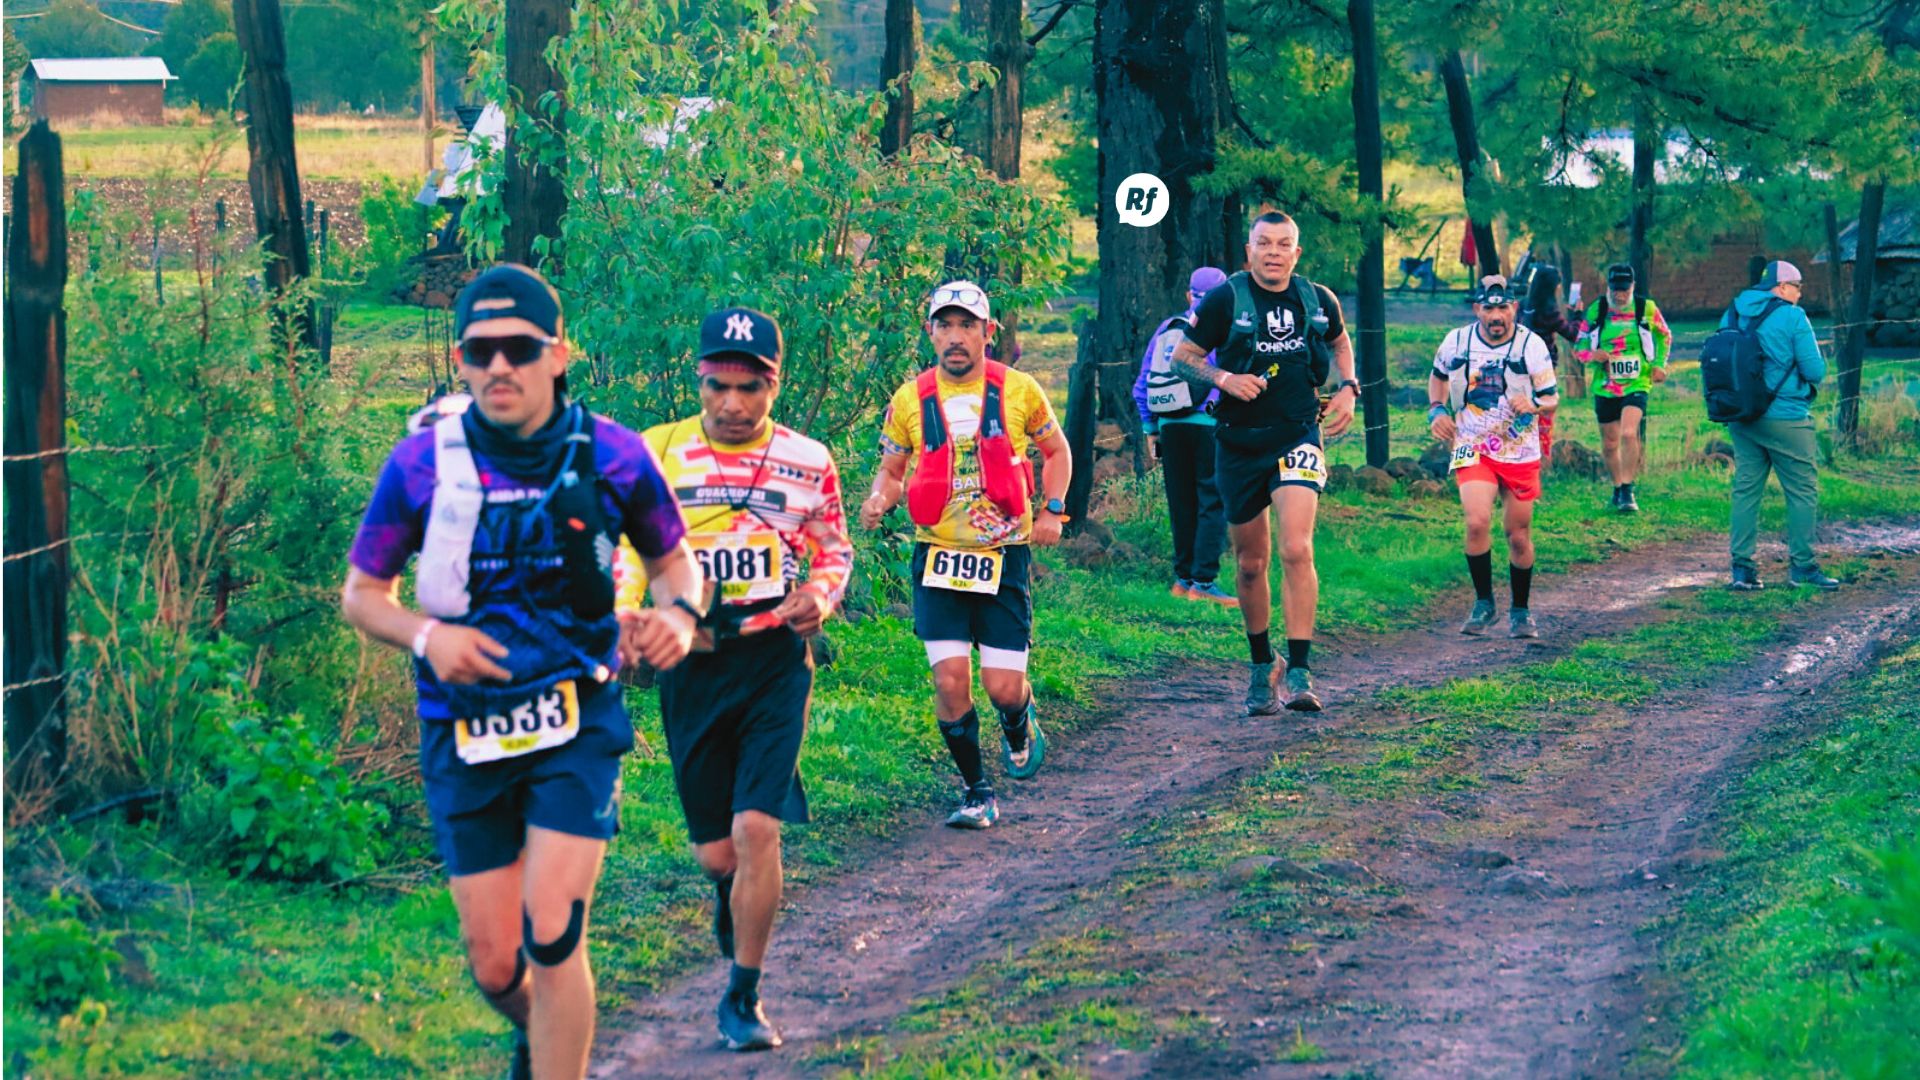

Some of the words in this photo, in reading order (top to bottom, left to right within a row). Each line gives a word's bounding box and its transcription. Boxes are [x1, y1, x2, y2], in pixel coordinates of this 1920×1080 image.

[723, 313, 754, 341] NY
[1611, 361, 1639, 375] 1064
[695, 547, 771, 581] 6081
[932, 551, 995, 582] 6198
